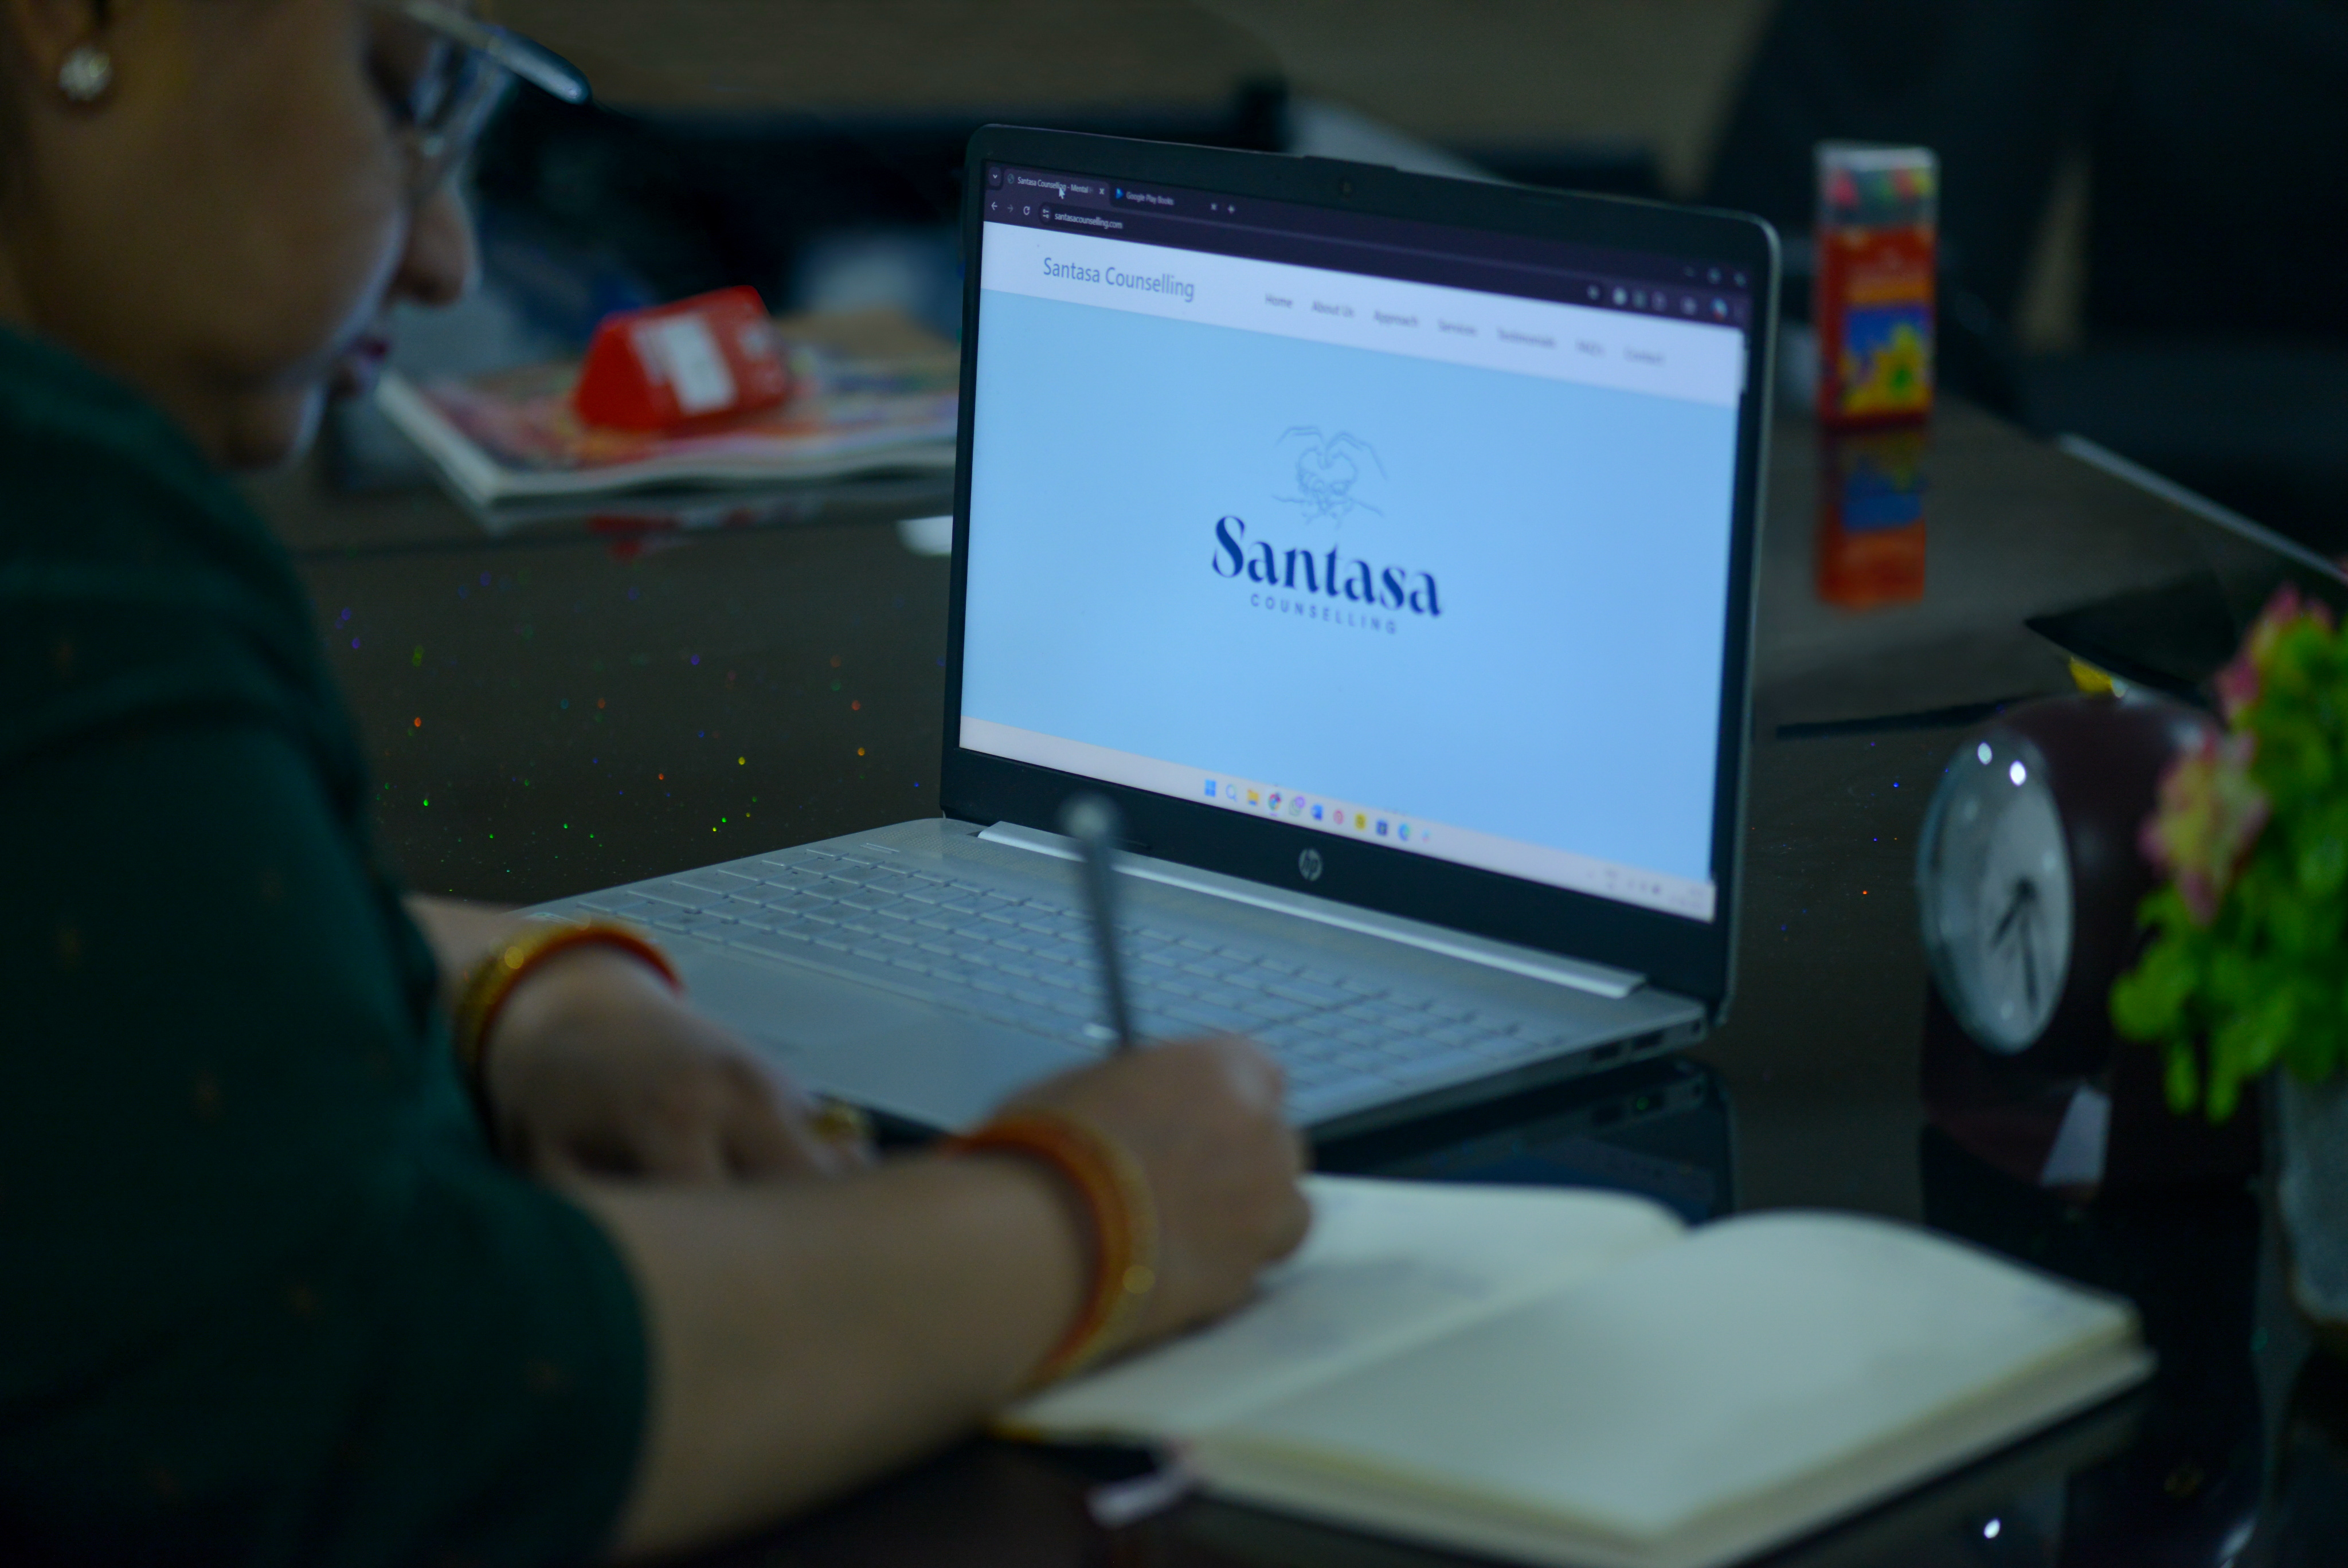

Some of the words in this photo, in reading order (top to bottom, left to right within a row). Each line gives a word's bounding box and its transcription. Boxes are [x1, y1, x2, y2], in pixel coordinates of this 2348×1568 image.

[1017, 177, 1037, 186] Santasa
[1070, 184, 1089, 194] Mental
[1126, 191, 1145, 203] Google
[1145, 194, 1157, 205] Play
[1157, 195, 1175, 206] Books
[1054, 213, 1124, 229] santasacounselling.com
[1043, 257, 1101, 283] Santasa
[1105, 266, 1195, 303] Counselling
[1265, 293, 1293, 308] Home
[1312, 300, 1340, 316] About
[1341, 305, 1355, 318] Us
[1373, 309, 1419, 327] Approach
[1211, 515, 1442, 618] Santasa
[1250, 593, 1396, 634] COUNSELLING
[1298, 848, 1323, 881] hp
